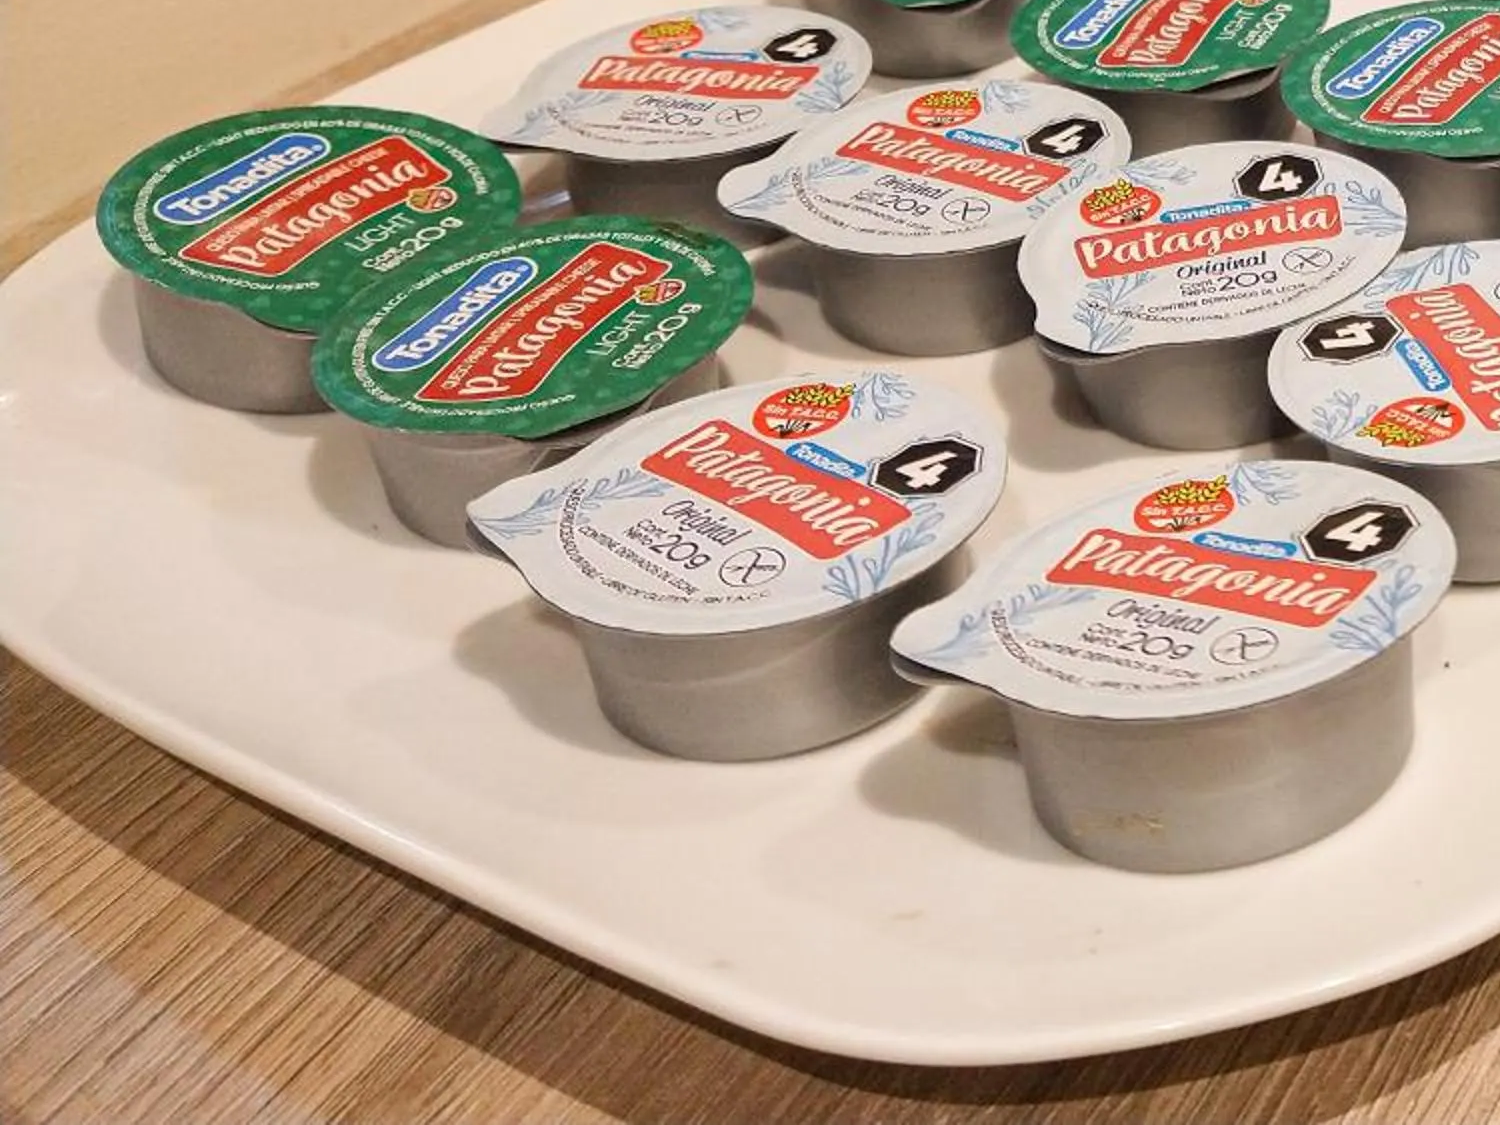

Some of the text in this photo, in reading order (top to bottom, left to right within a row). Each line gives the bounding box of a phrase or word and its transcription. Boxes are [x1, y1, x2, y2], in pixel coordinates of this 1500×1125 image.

[779, 34, 820, 58] 4
[1337, 27, 1428, 92] Tonadita
[589, 59, 801, 93] Patagonia
[1041, 124, 1086, 153] 4
[850, 124, 1048, 194] Patagonia
[1258, 163, 1302, 192] 4
[167, 145, 313, 215] Tonadita
[219, 160, 428, 268] Patagonia
[878, 194, 931, 217] 20g
[344, 213, 415, 251] LIGHT
[400, 216, 464, 251] 20g
[1081, 206, 1339, 268] Patagonia
[1176, 251, 1267, 280] Original
[1219, 271, 1277, 291] 20g
[386, 271, 520, 360] Tonadita
[458, 260, 647, 396] Patagonia
[586, 310, 650, 355] LIGHT
[644, 303, 702, 343] 20g
[1320, 321, 1375, 348] 4
[665, 427, 880, 547] Patagonia
[896, 451, 958, 488] 4
[662, 500, 752, 546] Original
[1324, 512, 1386, 551] 4
[651, 534, 711, 570] 20g
[1063, 535, 1352, 616] Patagonia
[1107, 599, 1220, 635] Original
[1120, 631, 1195, 660] 20g
